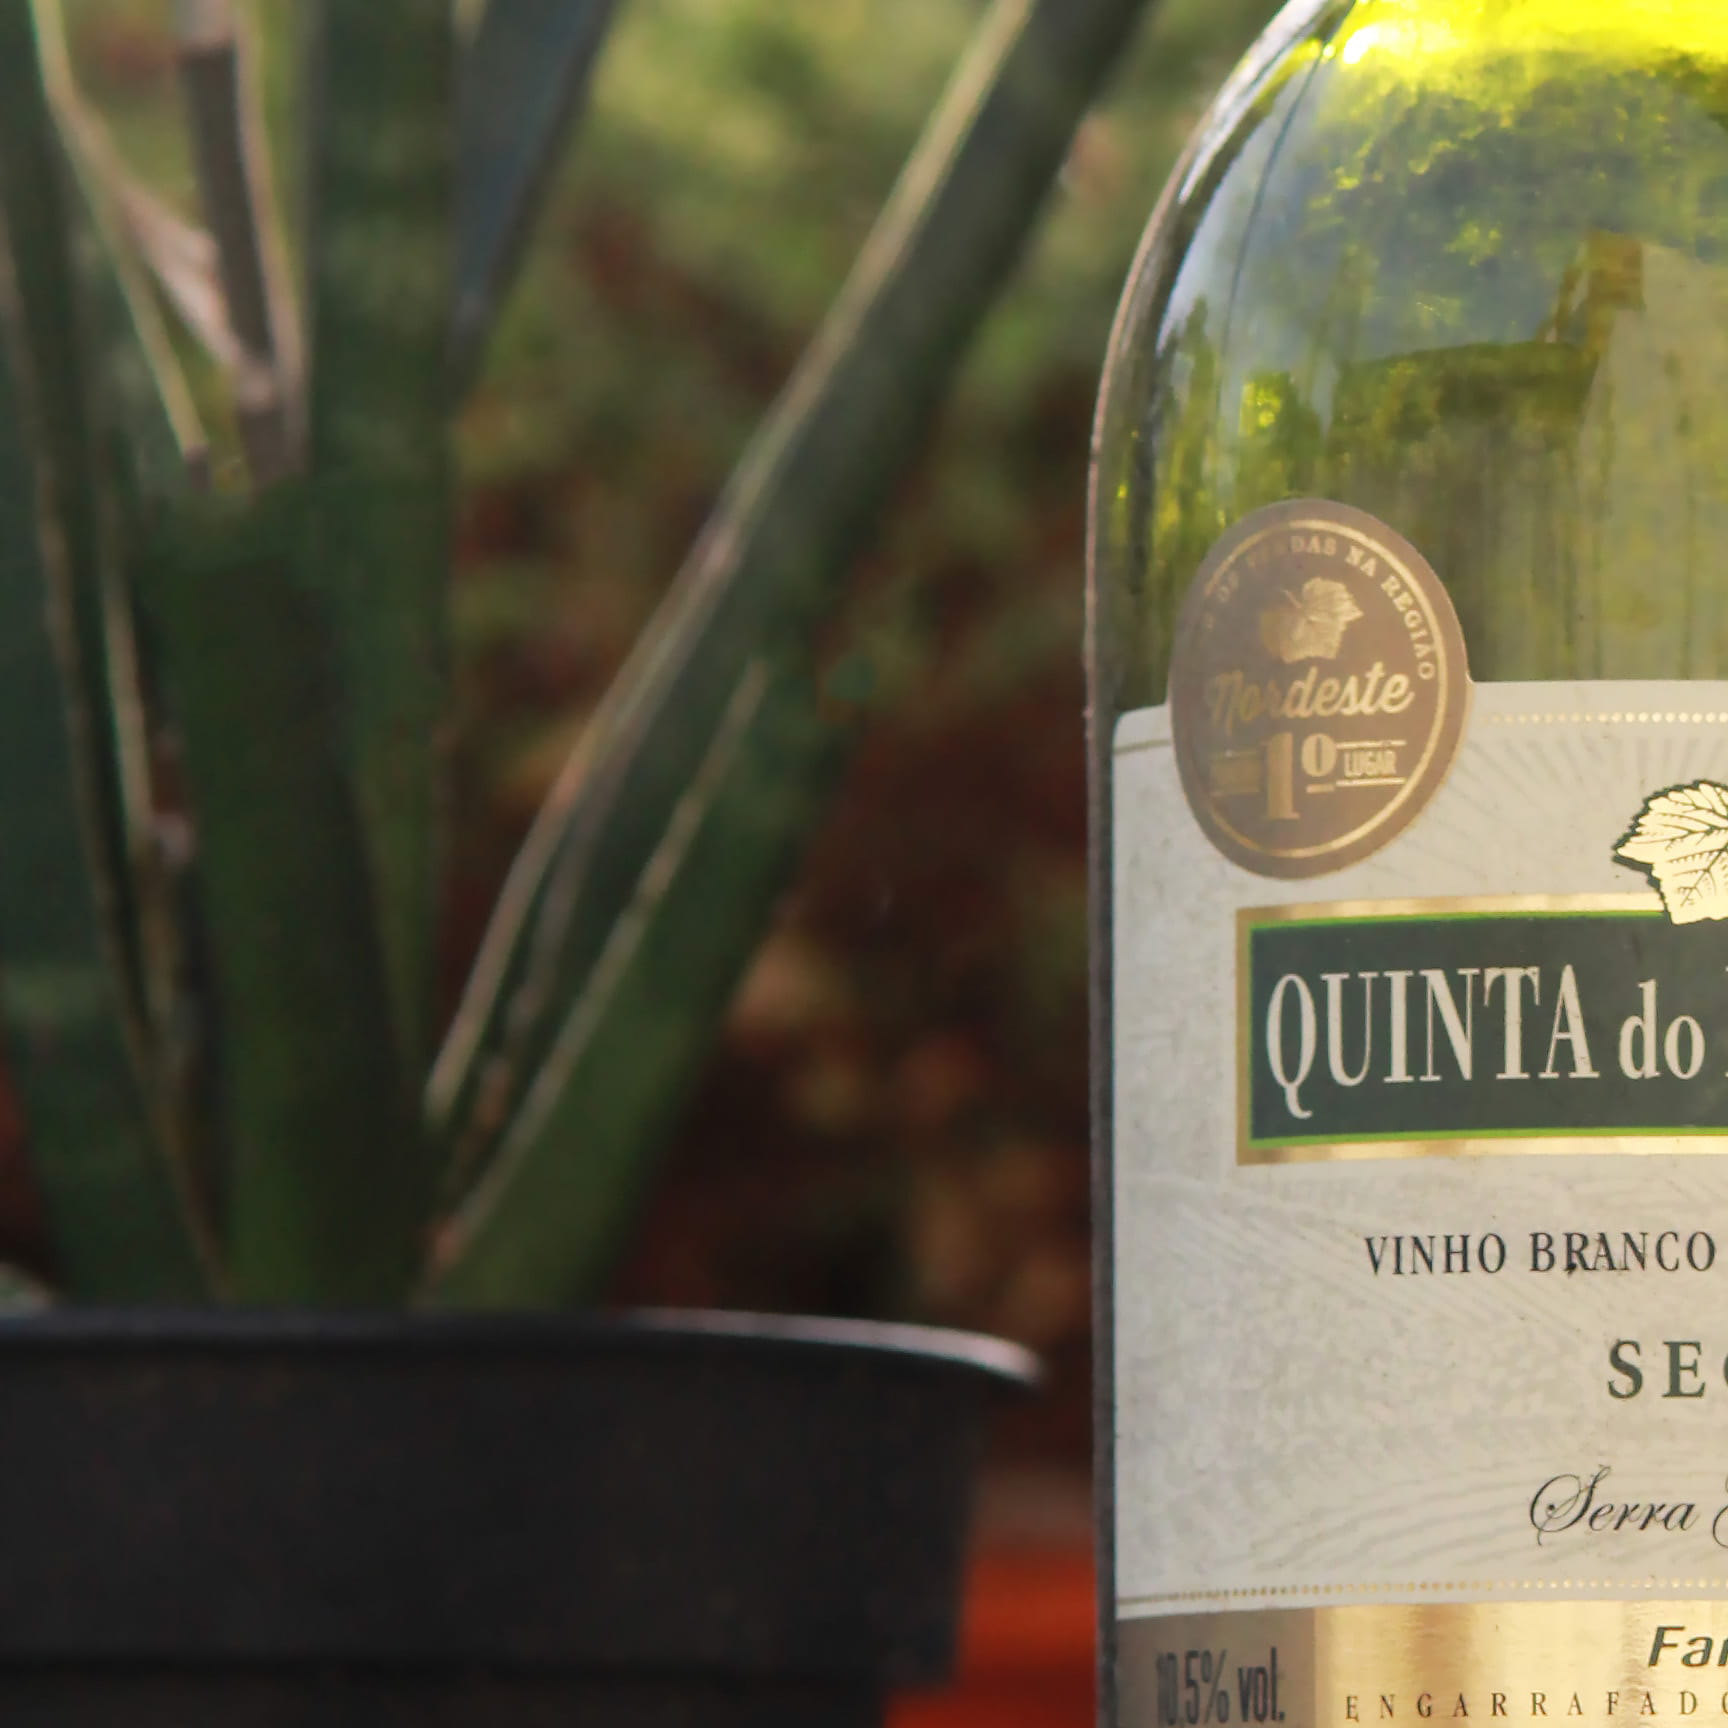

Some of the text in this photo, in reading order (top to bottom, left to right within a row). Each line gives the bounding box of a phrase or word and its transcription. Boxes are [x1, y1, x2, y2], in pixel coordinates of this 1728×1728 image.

[1344, 544, 1378, 578] NA
[1205, 661, 1417, 738] Nordeste
[1343, 749, 1398, 778] LUGAR
[1266, 964, 1601, 1119] QUINTA
[1618, 978, 1706, 1080] do
[1363, 1232, 1507, 1275] VINHO
[1528, 1230, 1718, 1273] BRANCO
[1528, 1464, 1697, 1547] Serra
[1237, 1645, 1287, 1723] vol.
